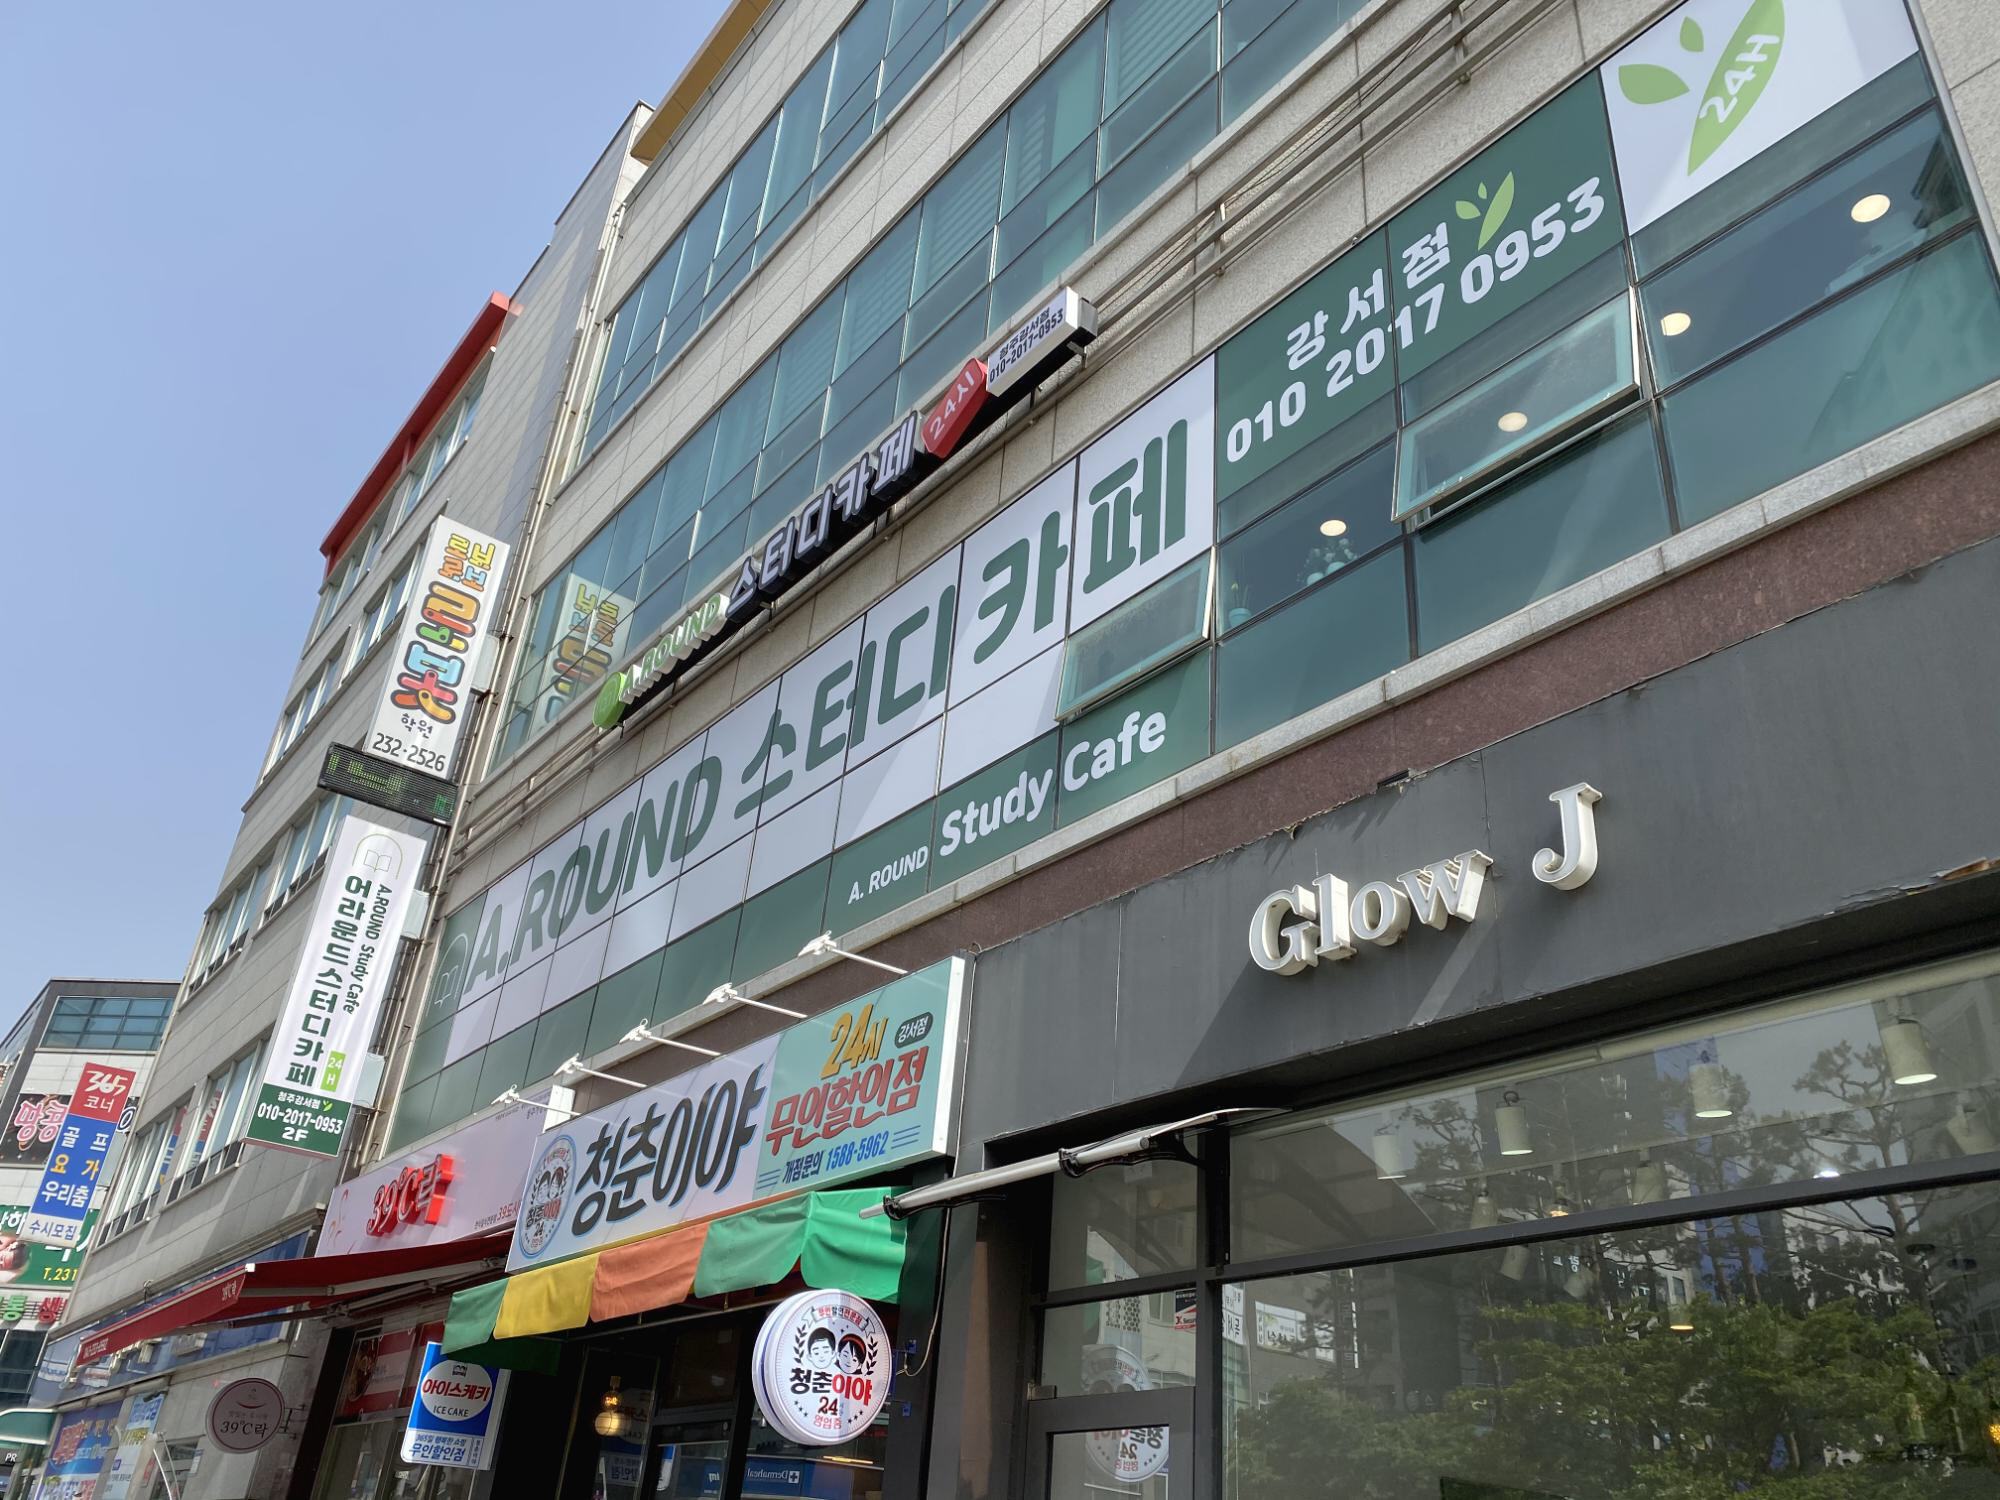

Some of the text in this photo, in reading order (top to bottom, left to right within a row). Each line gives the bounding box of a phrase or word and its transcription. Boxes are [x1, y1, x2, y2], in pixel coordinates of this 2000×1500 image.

[1698, 34, 1780, 123] 24H
[1227, 177, 1605, 463] 010 2017 0953
[989, 309, 1064, 383] 010-2017-0953
[725, 410, 919, 619] 스터디카페
[734, 418, 1188, 819] 스터디카페
[400, 712, 434, 739] 학원
[868, 845, 928, 894] ROUND
[940, 769, 1053, 857] Study
[1063, 711, 1167, 792] Cafe
[1249, 782, 1602, 976] Glow J
[350, 944, 375, 982] Study
[343, 983, 364, 1015] Cafe
[820, 1002, 889, 1080] 24시
[898, 1016, 929, 1043] 강서점
[328, 1057, 343, 1070] 24
[84, 1070, 128, 1097] 365
[766, 1045, 929, 1156] 무인할인점
[83, 1095, 115, 1112] 코너
[257, 1102, 343, 1134] 010-2017-0953
[281, 1127, 309, 1141] 2F
[571, 1063, 770, 1236] 청춘이야
[784, 1130, 889, 1185] 개점문의 1588-5962
[41, 1181, 90, 1208] 우리춤
[29, 1219, 77, 1240] 수시모집
[422, 1378, 491, 1402] 아이스케키
[789, 1368, 873, 1406] 청춘이야
[433, 1405, 469, 1418] ICE CAKE
[409, 1443, 466, 1462] 무인할인점
